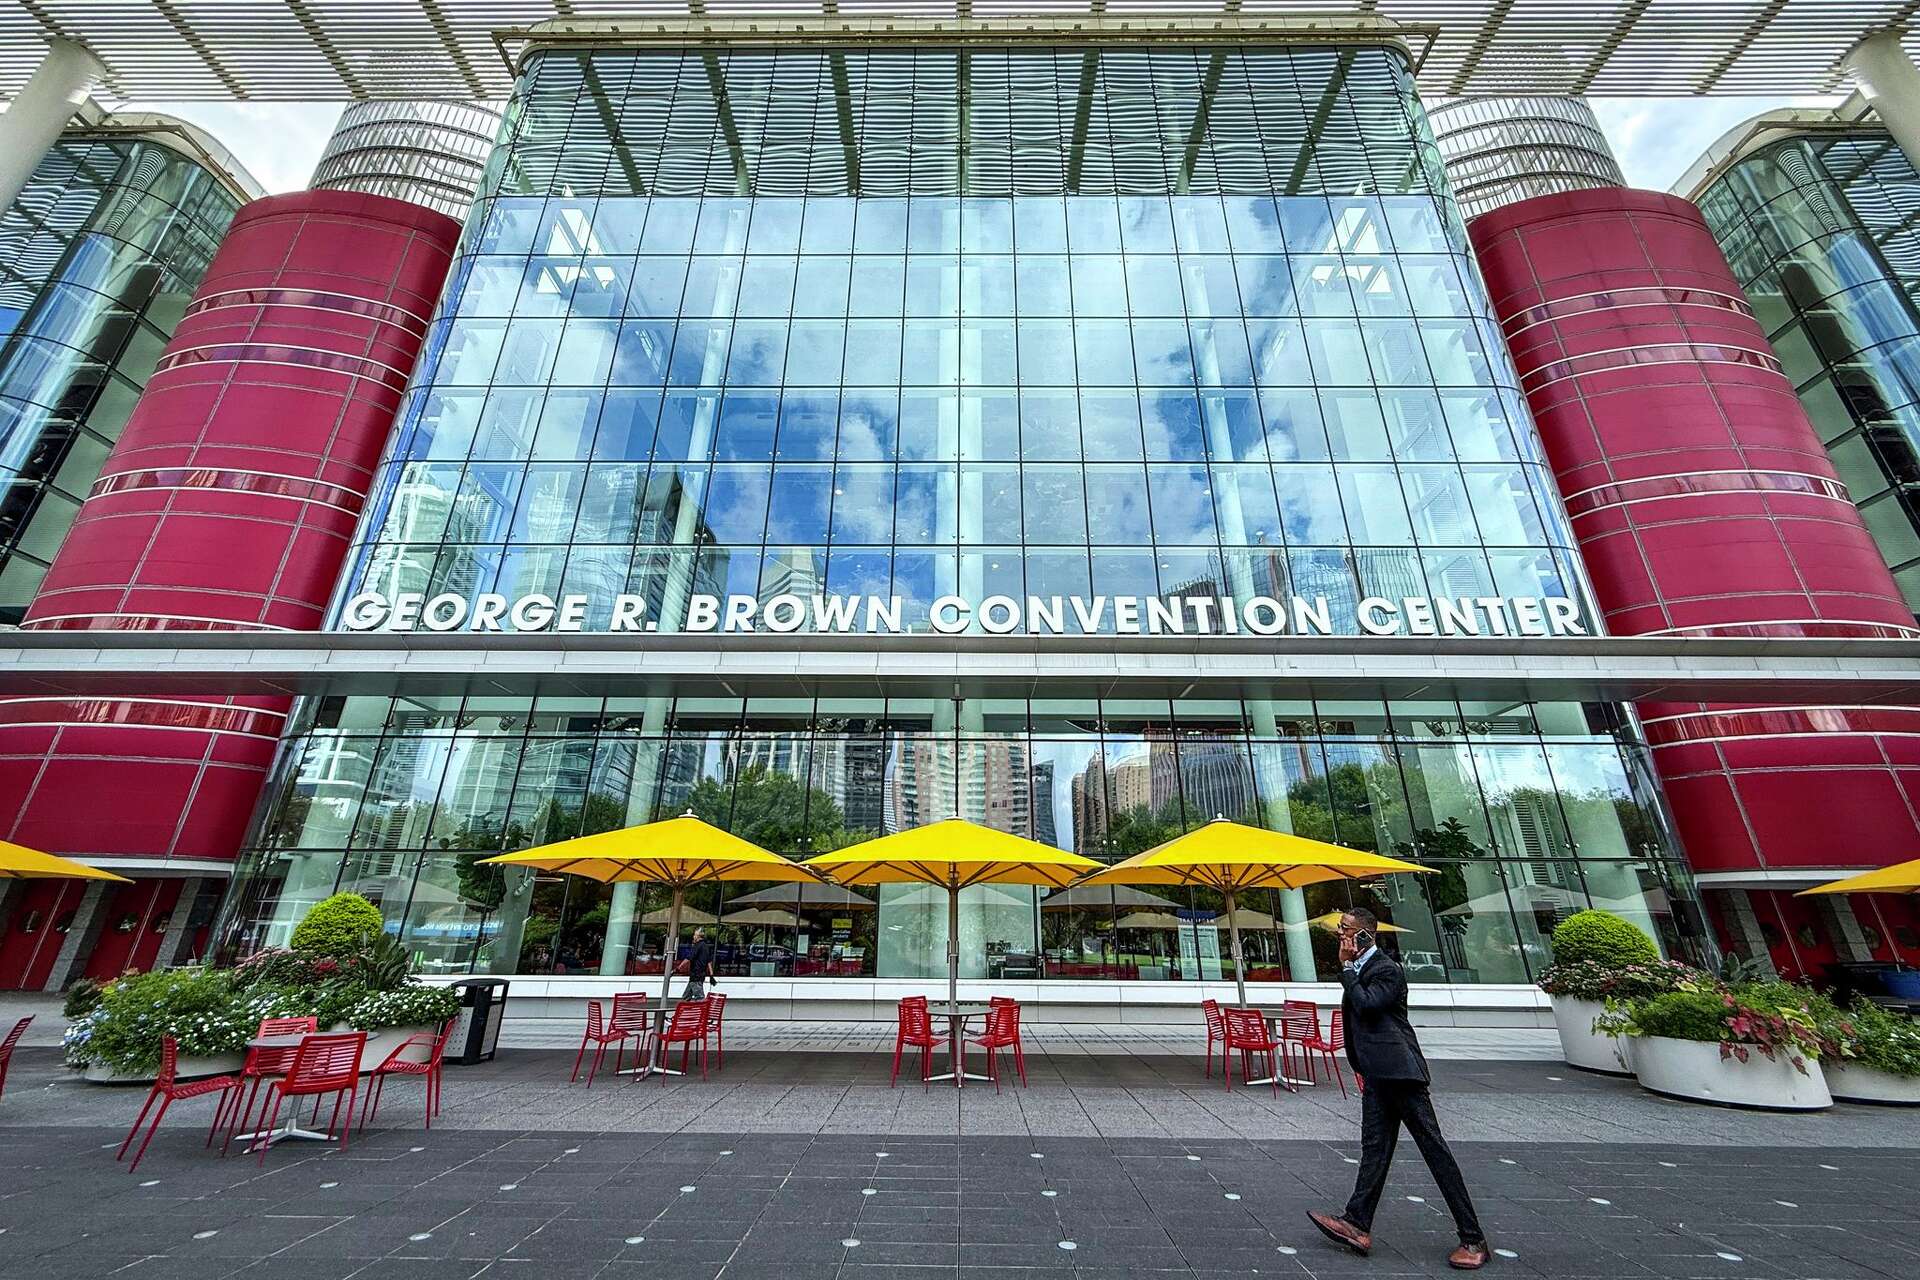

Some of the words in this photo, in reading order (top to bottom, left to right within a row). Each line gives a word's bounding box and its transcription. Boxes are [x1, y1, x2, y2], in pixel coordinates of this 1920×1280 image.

[344, 592, 588, 631] GEORGE
[610, 594, 657, 631] R.
[686, 594, 902, 632] BROWN
[929, 595, 1332, 634] CONVENTION
[1357, 597, 1586, 635] CENTER
